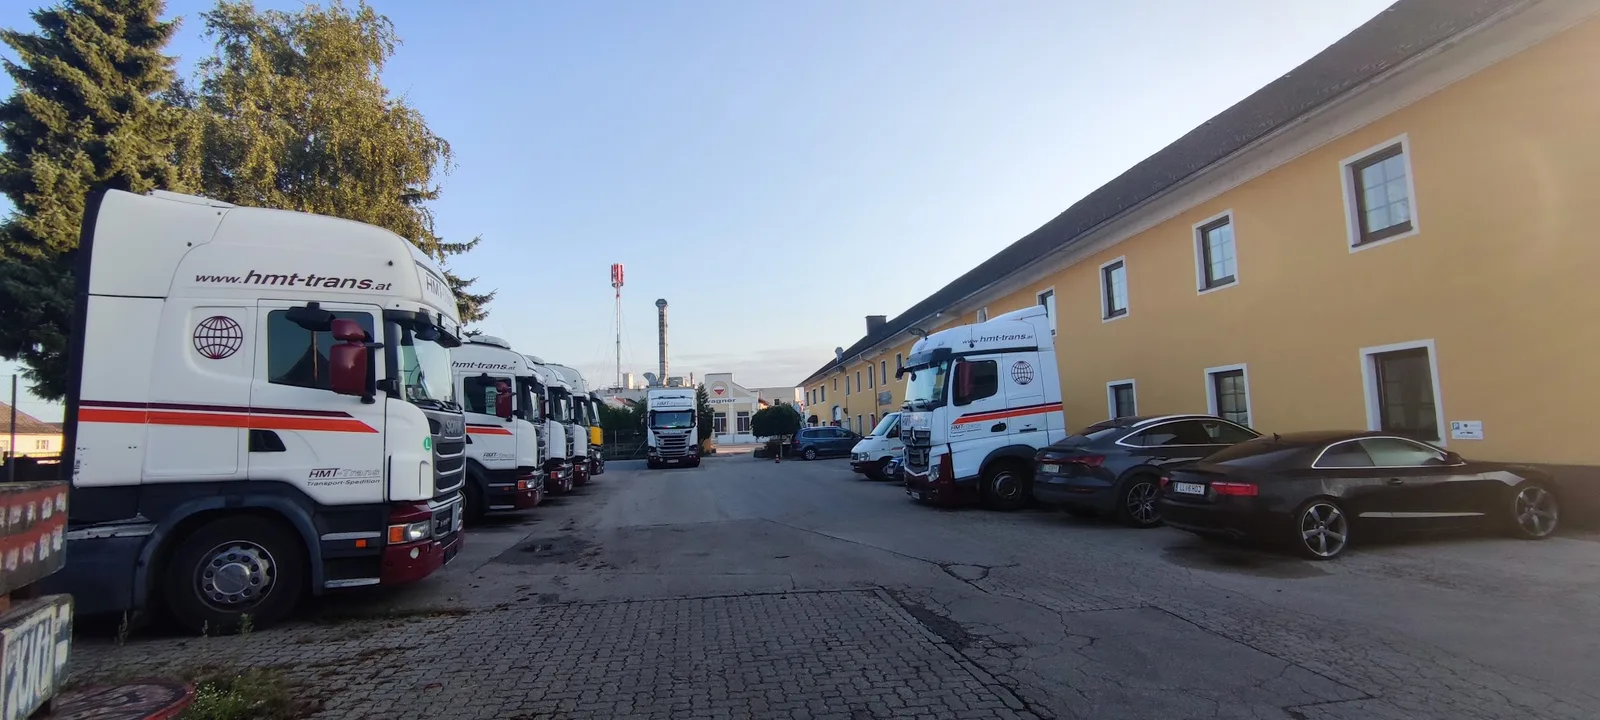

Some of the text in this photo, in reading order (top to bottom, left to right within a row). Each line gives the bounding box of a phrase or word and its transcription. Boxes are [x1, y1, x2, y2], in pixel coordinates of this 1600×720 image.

[195, 270, 392, 291] www.hmt-trans.at
[308, 468, 380, 478] HMT-Trans
[307, 479, 380, 487] Transport-Spedition
